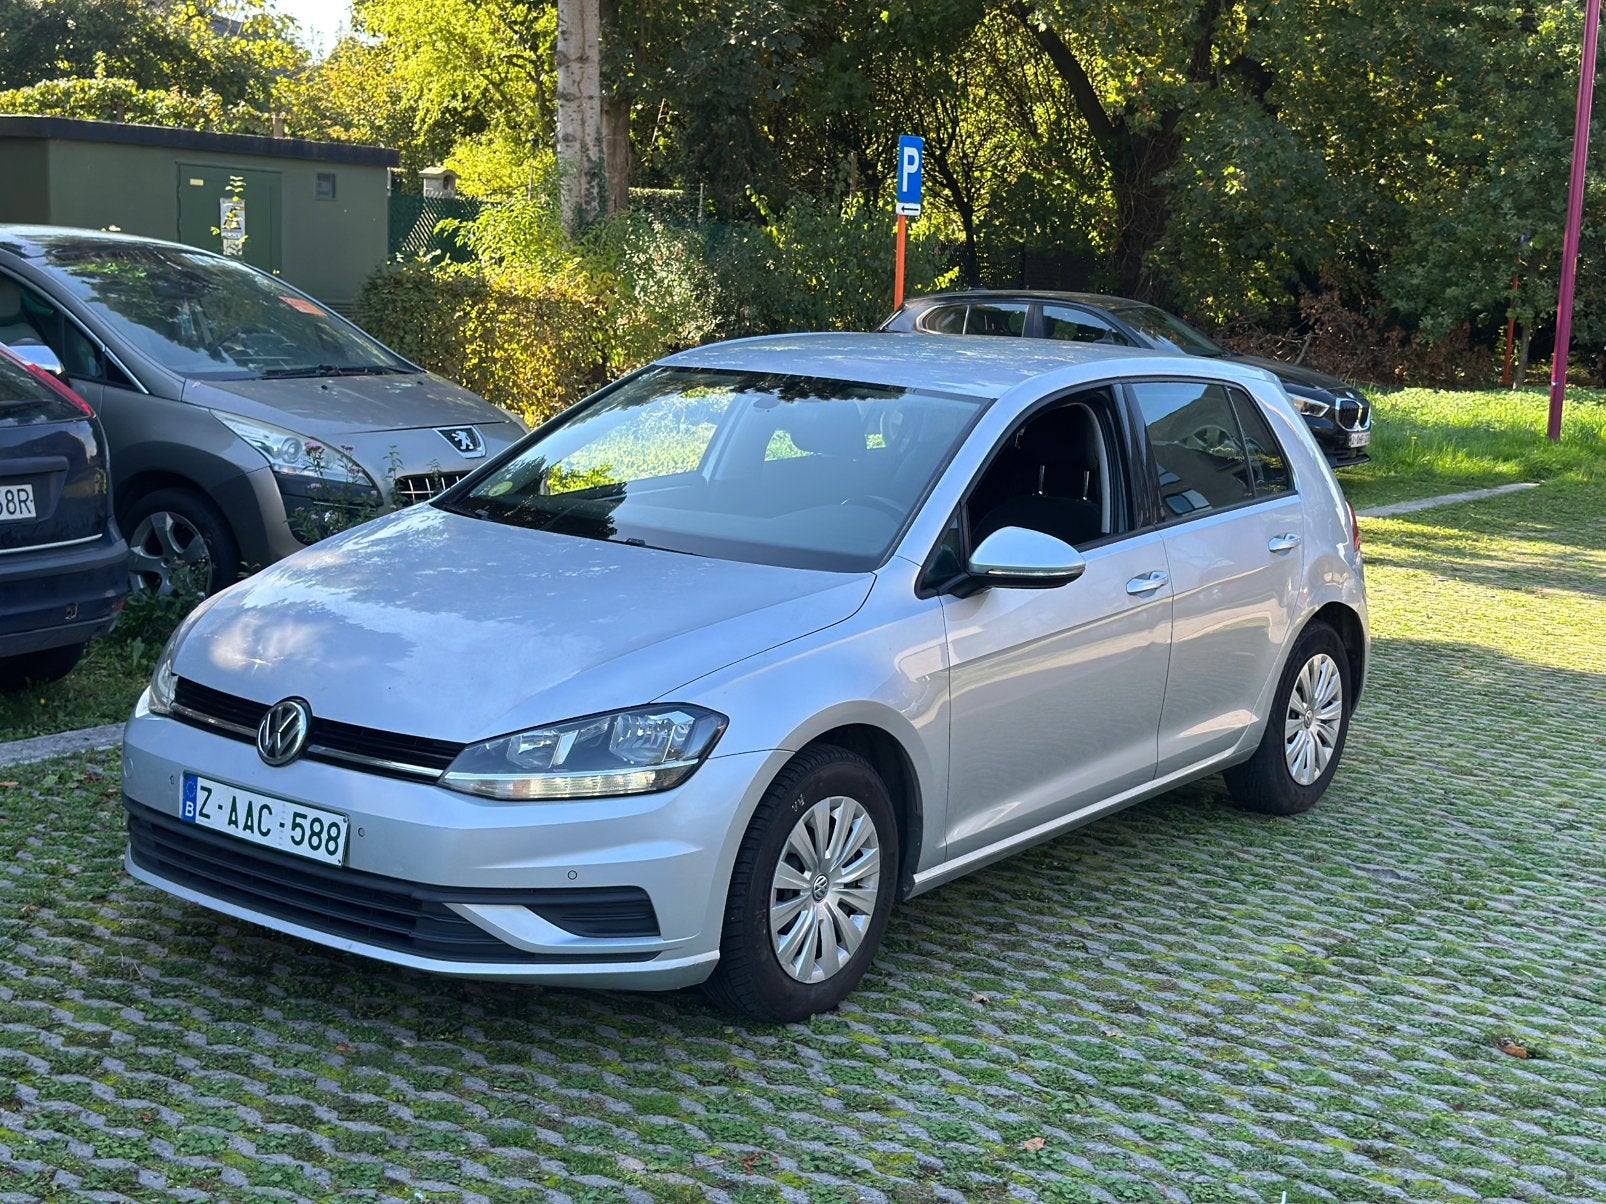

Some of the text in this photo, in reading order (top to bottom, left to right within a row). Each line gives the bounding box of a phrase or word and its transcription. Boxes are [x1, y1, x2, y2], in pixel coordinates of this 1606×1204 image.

[902, 146, 920, 193] P
[185, 801, 195, 817] B
[198, 785, 341, 857] Z-AAC-588
